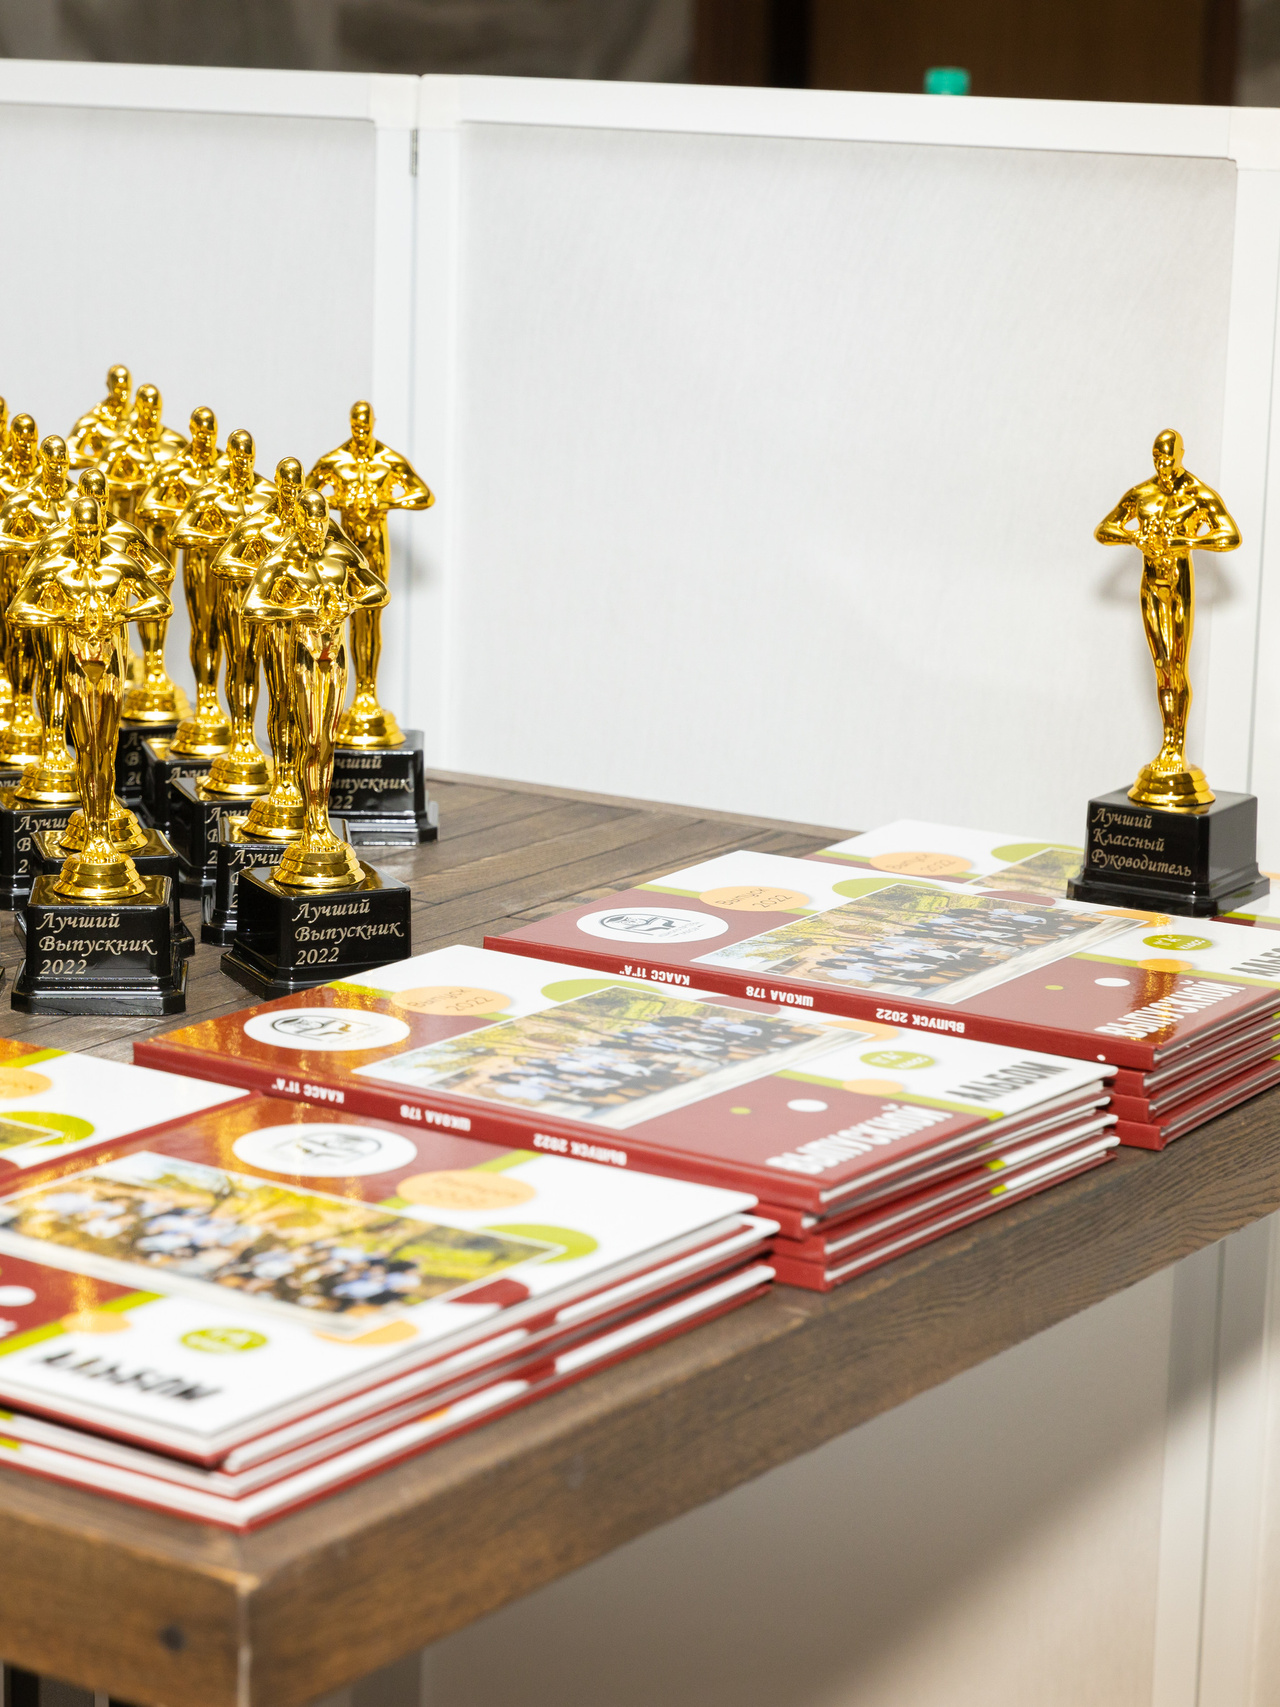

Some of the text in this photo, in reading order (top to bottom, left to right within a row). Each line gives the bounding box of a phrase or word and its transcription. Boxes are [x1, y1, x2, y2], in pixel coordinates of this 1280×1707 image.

[334, 755, 382, 770] чший
[14, 815, 68, 833] Лучш
[1091, 808, 1152, 829] Лучший
[1093, 828, 1165, 852] Классный
[227, 849, 283, 869] Лучш
[1091, 849, 1192, 877] Руководитель
[291, 898, 371, 924] Лучший
[752, 894, 793, 909] 2022
[35, 912, 120, 934] Лучший
[294, 921, 405, 945] Выпускник
[39, 935, 158, 957] Выпускник
[295, 946, 340, 965] 2022
[40, 959, 87, 975] 2022
[650, 968, 690, 986] КЛАСС
[746, 985, 814, 1008] ШКОЛА 178
[1094, 979, 1247, 1039] ВЫПУСКНОЙ
[875, 1007, 965, 1034] ВЫПУСК 2022
[945, 1061, 1070, 1102] АЛЬБОМ
[303, 1083, 345, 1104] КЛАСС
[400, 1104, 471, 1132] ШКОЛА 178
[533, 1132, 628, 1167] ВЫПУСК 2022
[765, 1103, 954, 1175] ВЫПУСКНОЙ
